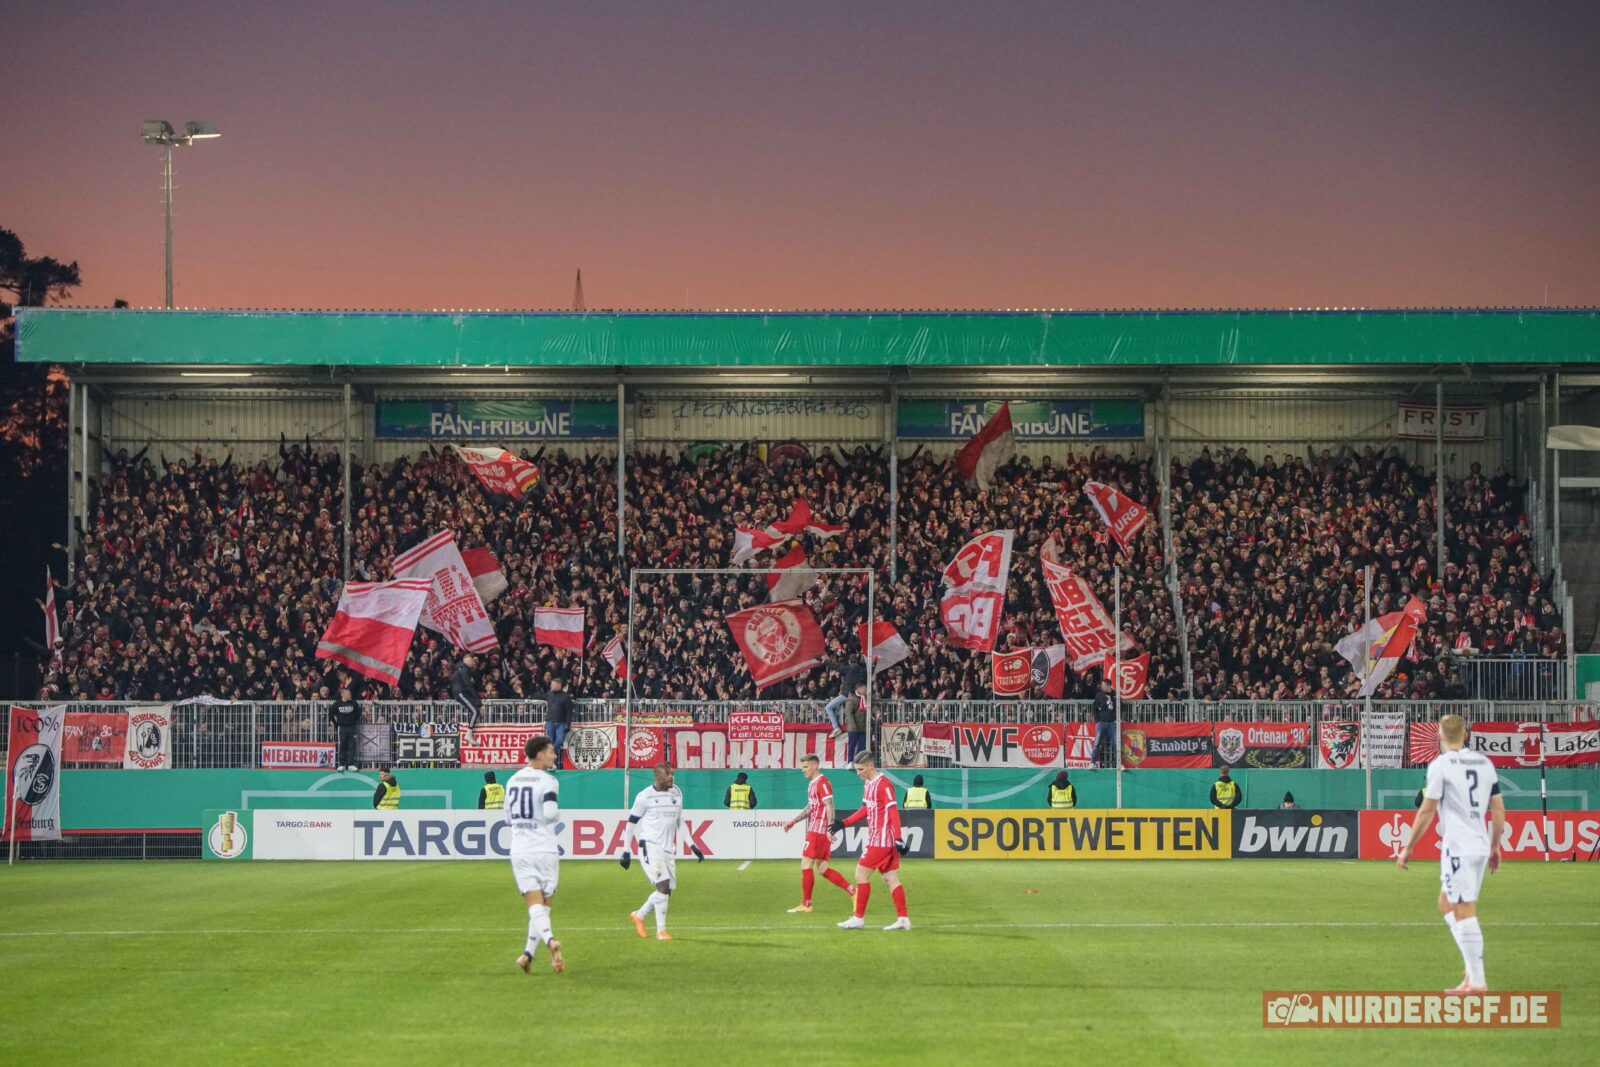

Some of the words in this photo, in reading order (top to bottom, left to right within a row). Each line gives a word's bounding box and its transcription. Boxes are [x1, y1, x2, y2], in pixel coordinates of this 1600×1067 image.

[16, 715, 60, 734] 100%
[730, 715, 782, 724] KHALID
[954, 726, 1018, 762] IWF
[1149, 737, 1208, 753] Knaddly's
[1248, 727, 1288, 744] Ortenau
[1475, 736, 1512, 753] Red
[128, 750, 166, 769] BOTSCHAFT
[263, 749, 334, 764] NIEDERHF
[464, 750, 519, 763] ULTRAS
[1465, 769, 1479, 807] 2
[509, 786, 534, 819] 20
[946, 816, 1219, 851] SPORTWETTEN
[1238, 814, 1349, 853] bwin
